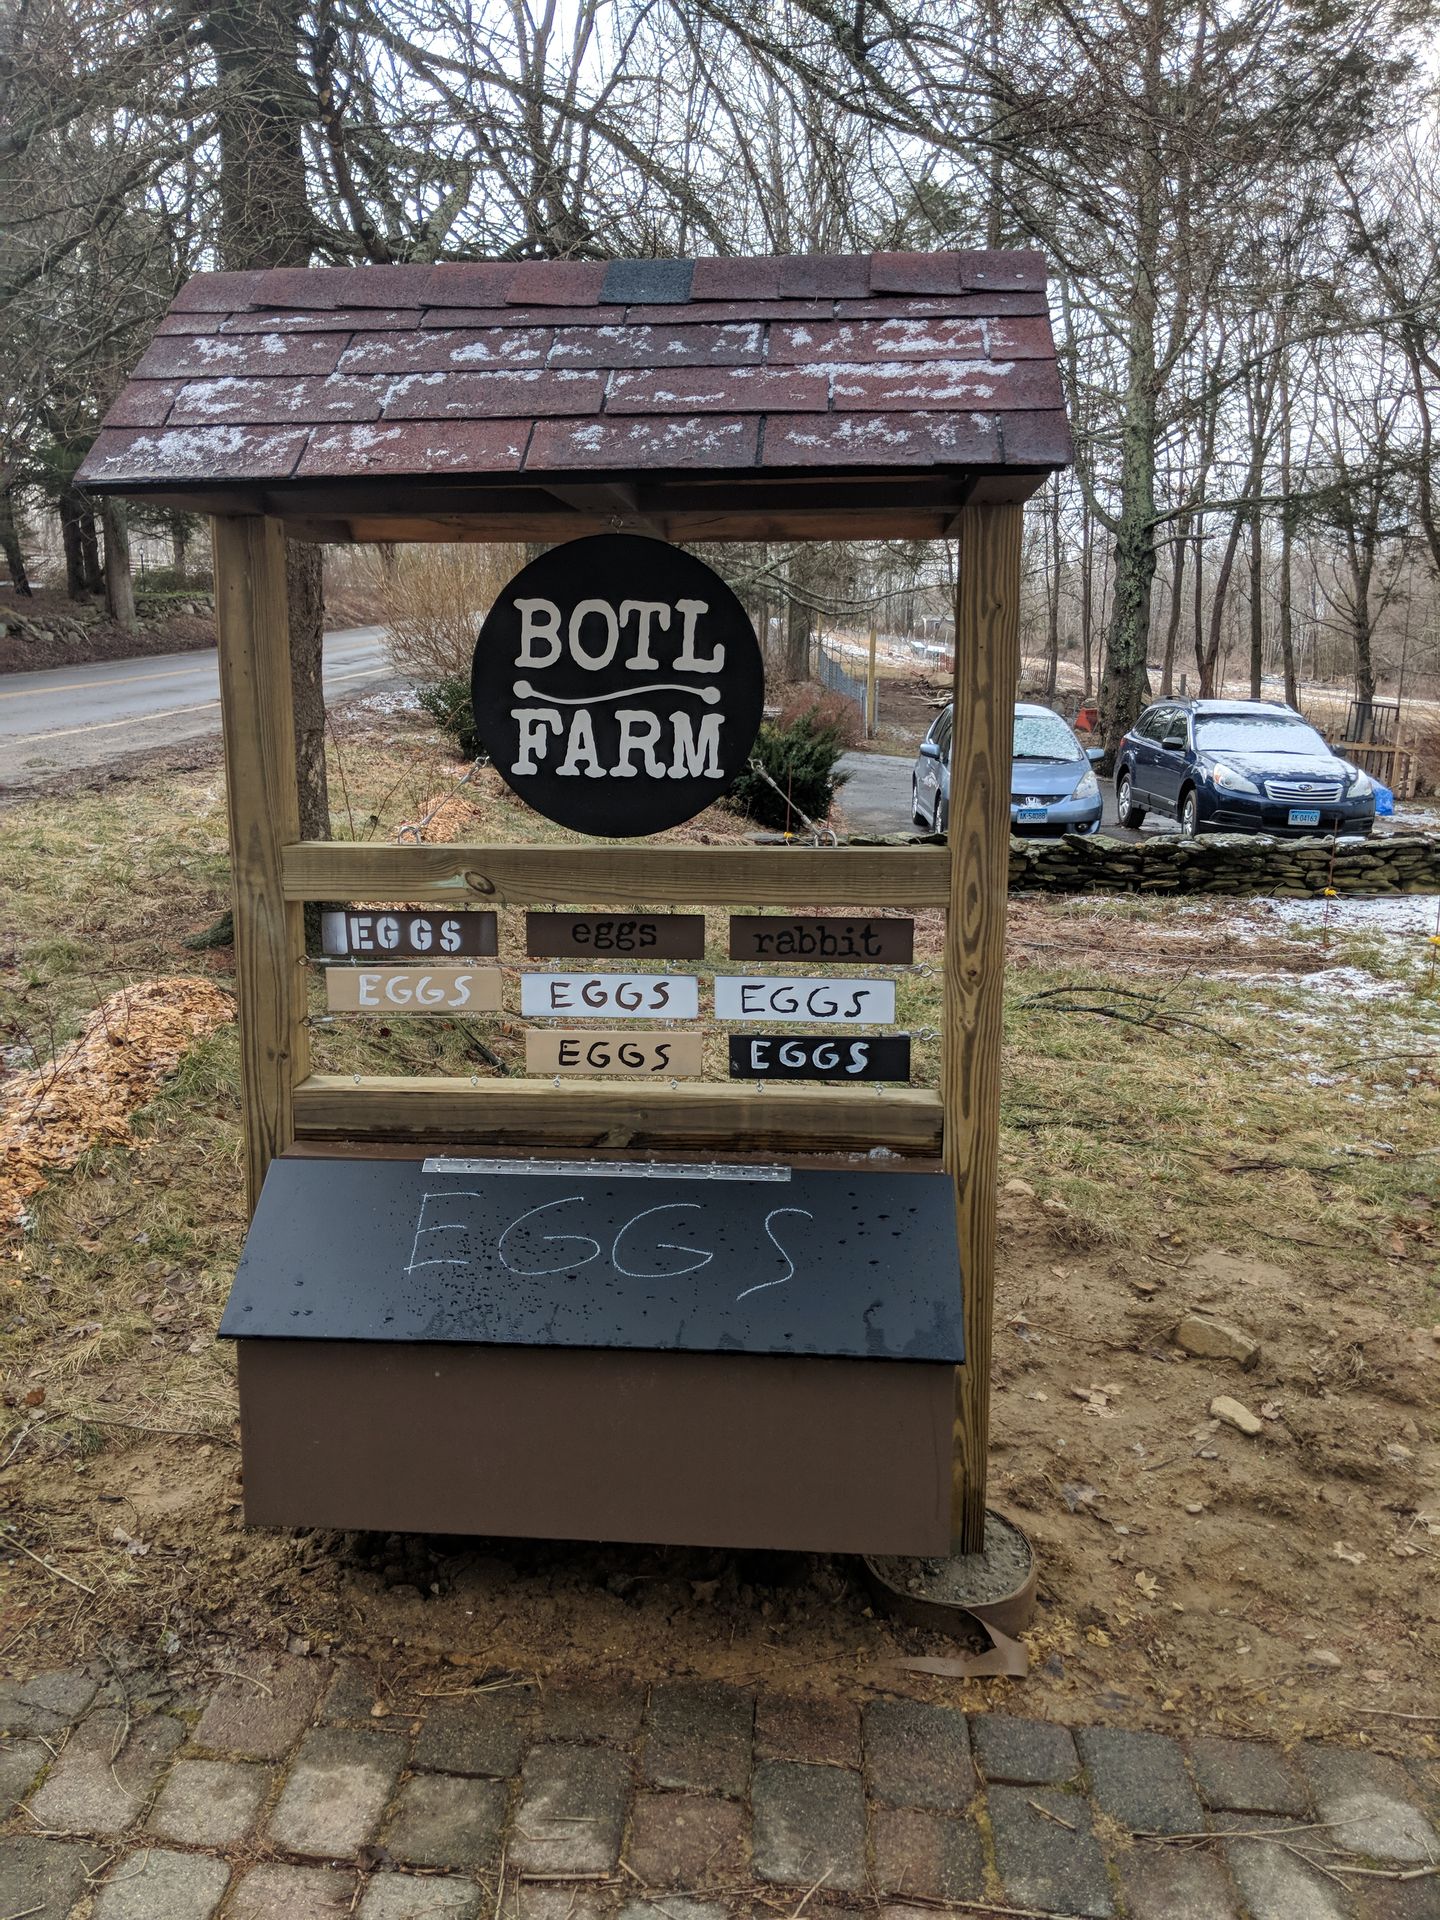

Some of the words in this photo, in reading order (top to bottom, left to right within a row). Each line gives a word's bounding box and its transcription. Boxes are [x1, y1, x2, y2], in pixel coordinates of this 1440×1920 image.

[513, 598, 726, 674] BOTL
[510, 708, 726, 779] FARM
[349, 916, 462, 953] EGGS
[571, 920, 658, 952] eggs
[752, 923, 883, 957] rabbit
[358, 973, 473, 1008] EGGS
[549, 979, 671, 1012] EGGS
[741, 984, 871, 1018] EGGS
[557, 1038, 673, 1072] EGGS
[750, 1039, 870, 1074] EGGS
[403, 1191, 814, 1302] EGGS
